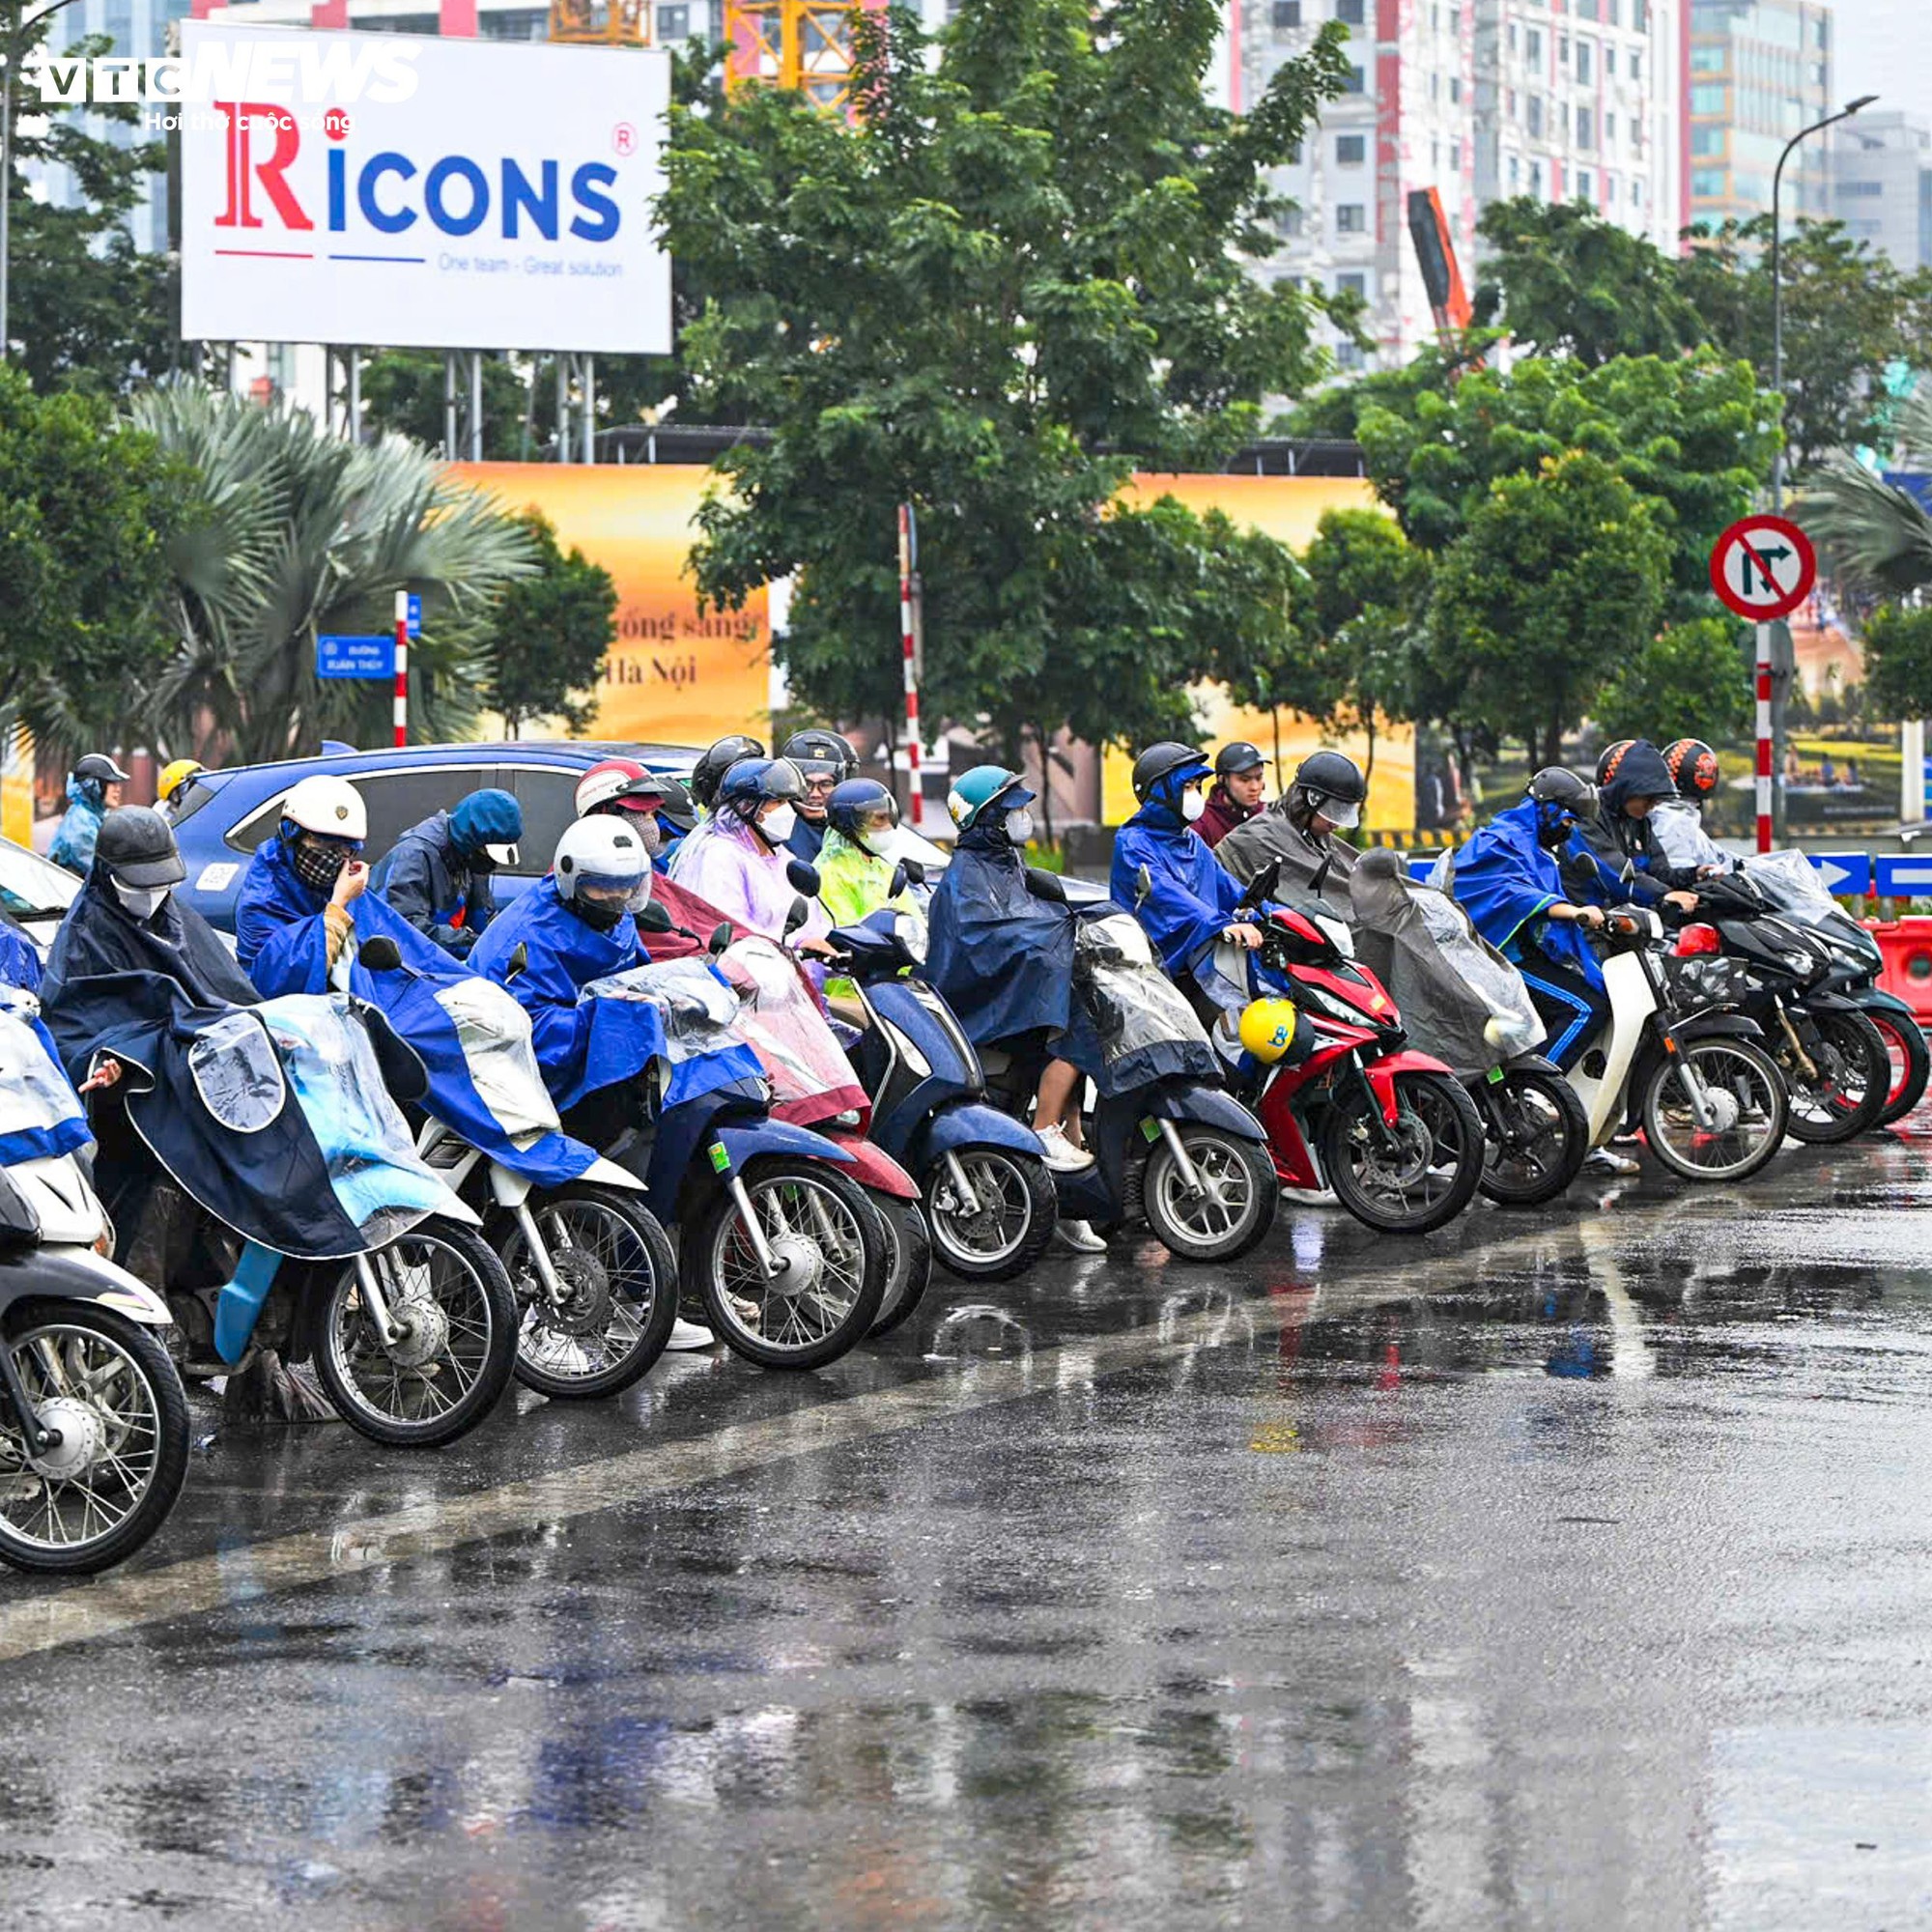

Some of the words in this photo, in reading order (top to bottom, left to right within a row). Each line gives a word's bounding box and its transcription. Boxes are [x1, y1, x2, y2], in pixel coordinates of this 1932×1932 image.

[439, 252, 469, 271] One
[473, 256, 509, 272] team
[523, 255, 563, 275] Great
[568, 258, 622, 278] solution
[616, 606, 675, 646] ống
[652, 654, 696, 691] Nội
